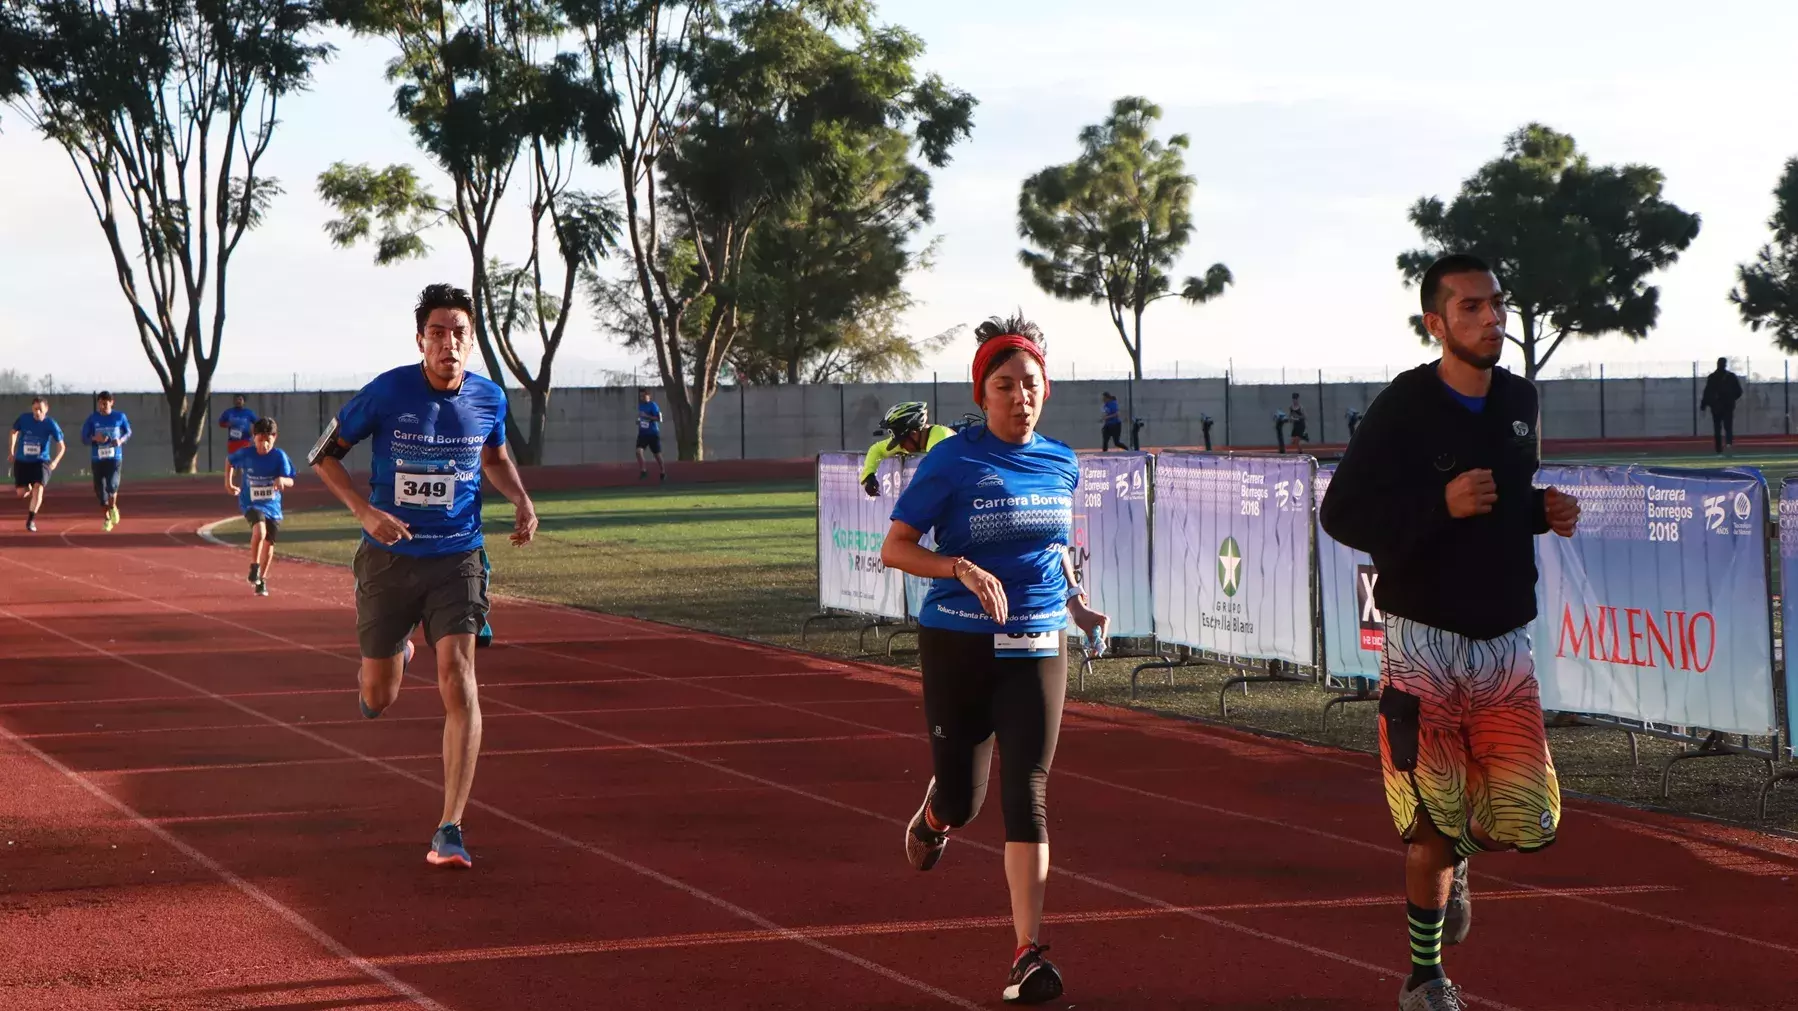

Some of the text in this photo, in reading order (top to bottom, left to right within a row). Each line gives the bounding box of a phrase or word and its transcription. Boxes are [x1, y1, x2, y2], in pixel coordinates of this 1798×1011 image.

[393, 429, 484, 445] Carrera Borregos
[455, 471, 474, 481] 2018
[1084, 466, 1107, 479] Carrera
[1241, 471, 1265, 484] Carrera
[403, 480, 447, 497] 349
[1084, 480, 1110, 493] Borregos
[1240, 485, 1269, 501] Borregos
[1647, 485, 1686, 501] Carrera
[973, 493, 1072, 510] Carrera Borreg
[1084, 493, 1103, 508] 2018
[1240, 500, 1261, 516] 2018
[1648, 502, 1693, 522] Borregos
[1648, 521, 1680, 542] 2018
[937, 604, 955, 616] Toluca
[958, 610, 979, 620] Santa
[979, 613, 989, 621] Fe
[1216, 601, 1241, 614] GRUPO
[1202, 612, 1253, 634] Estrella Blanca
[1555, 602, 1716, 673] MILENIO
